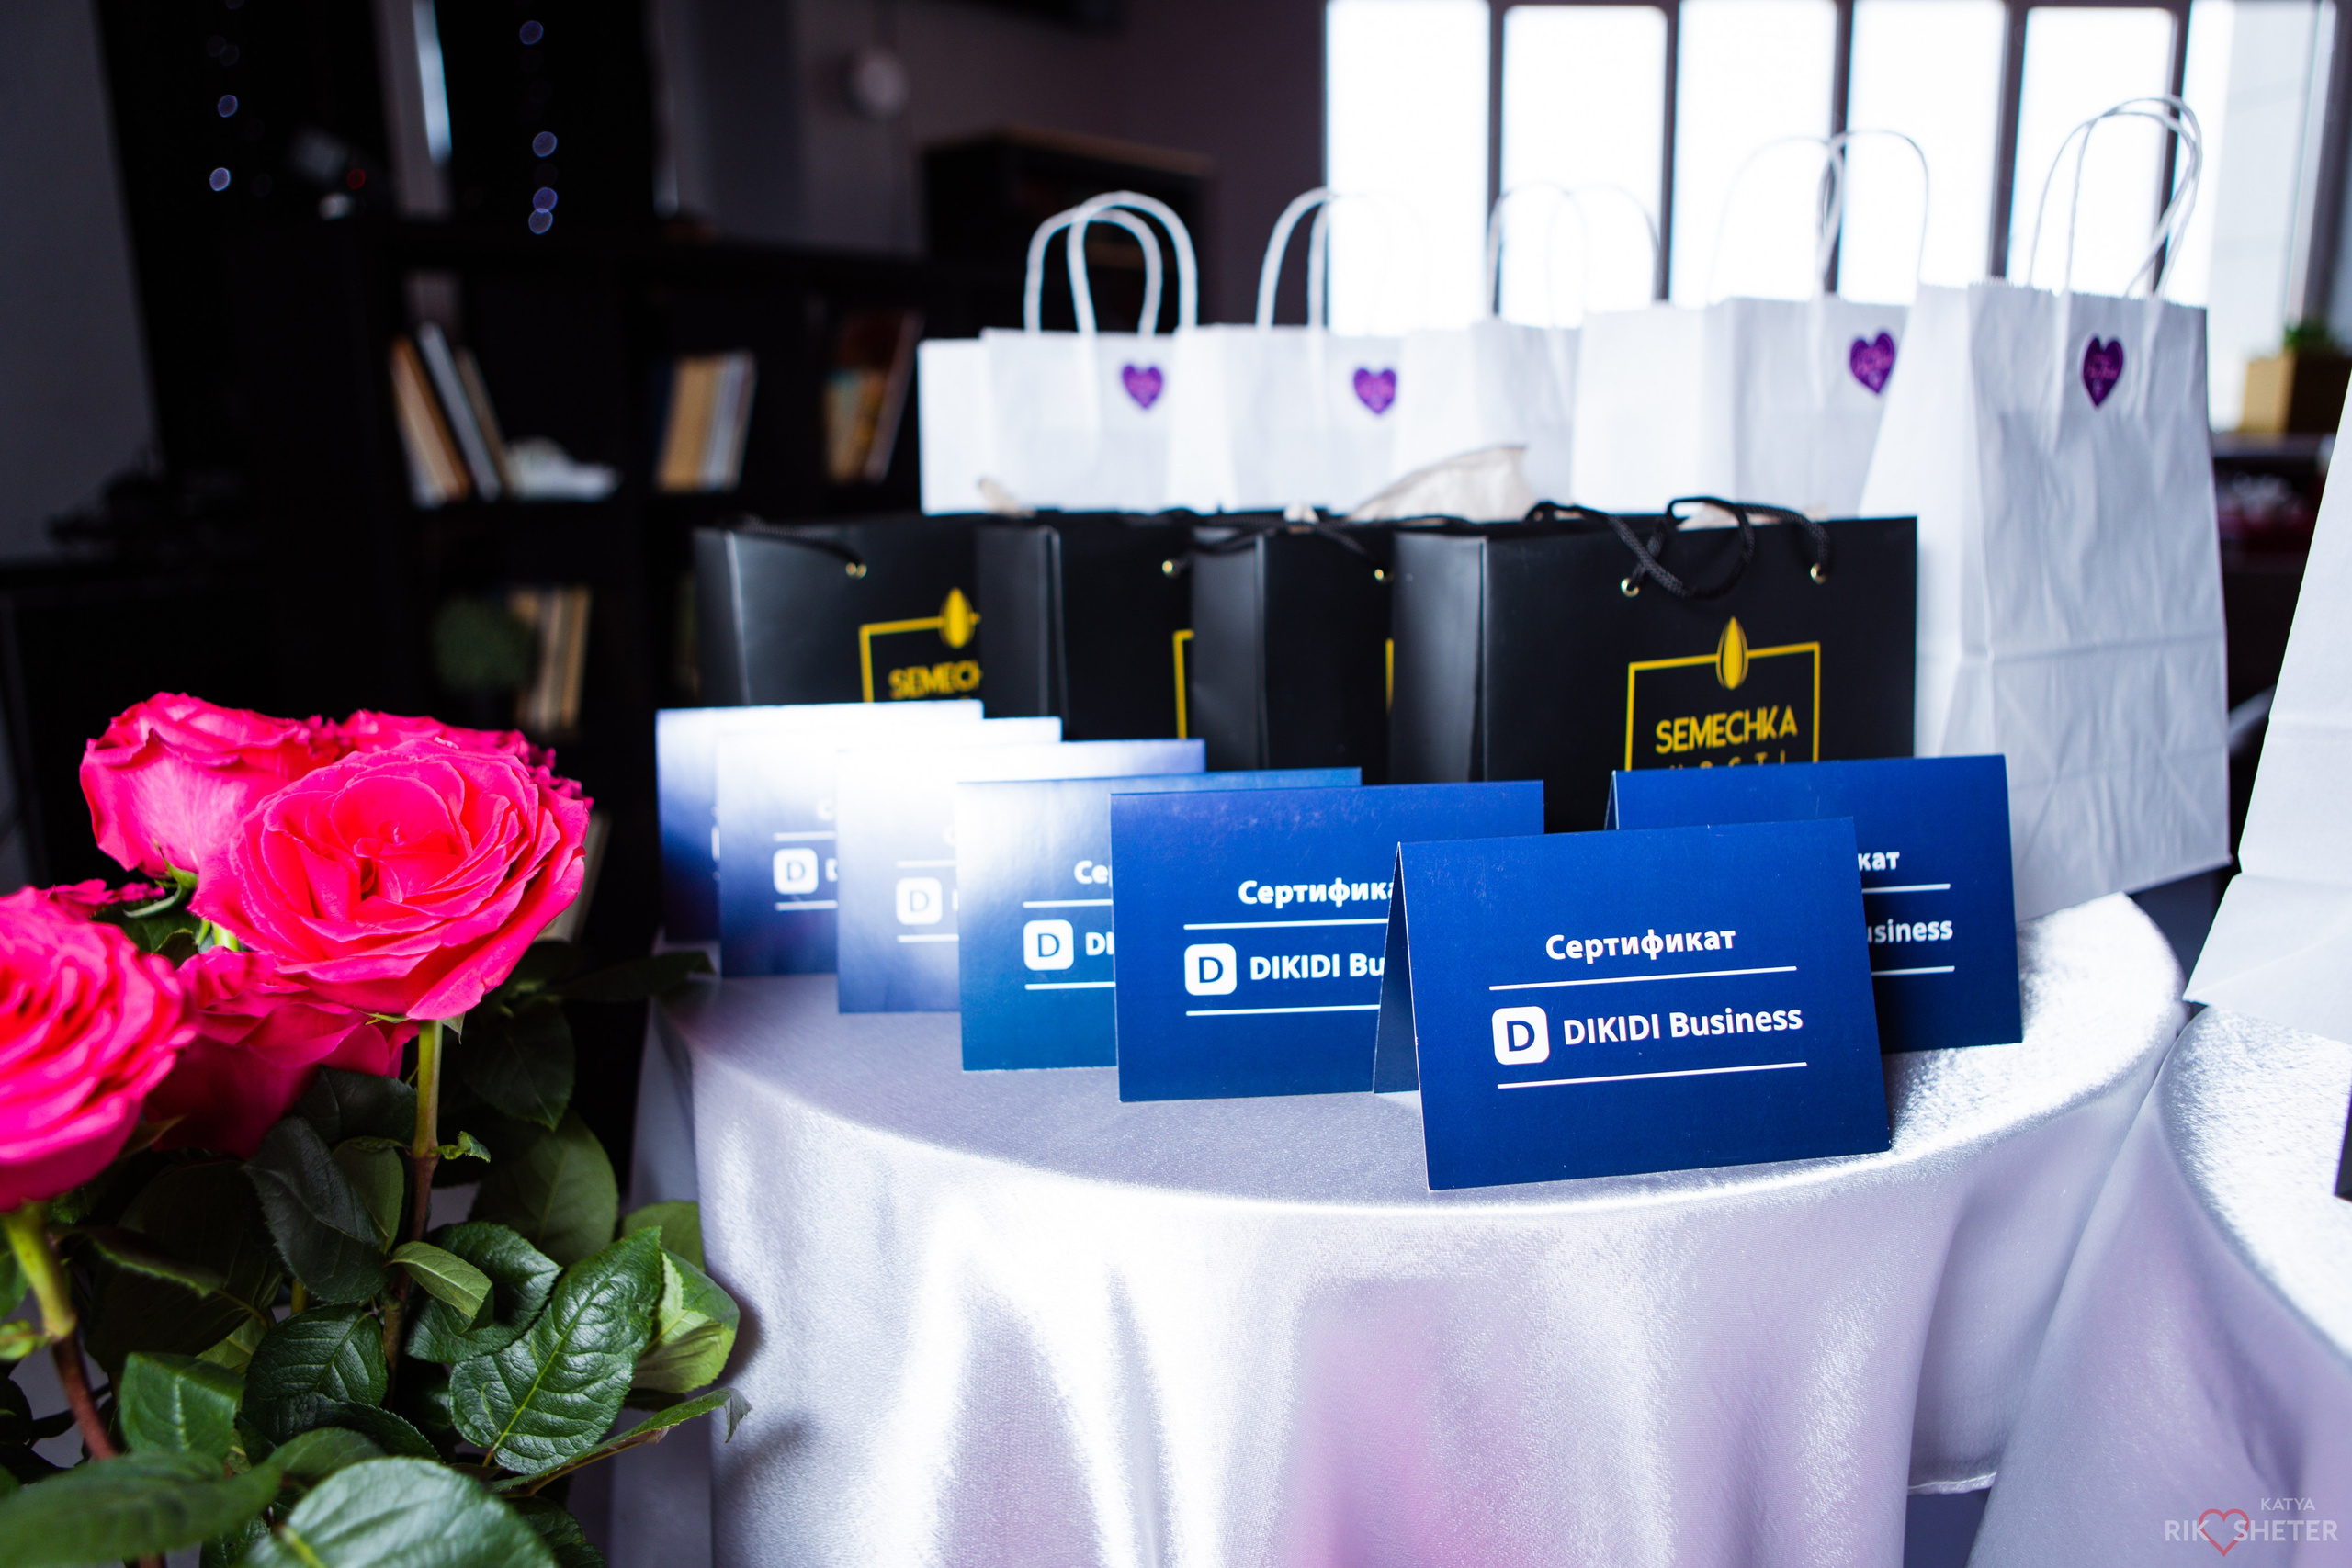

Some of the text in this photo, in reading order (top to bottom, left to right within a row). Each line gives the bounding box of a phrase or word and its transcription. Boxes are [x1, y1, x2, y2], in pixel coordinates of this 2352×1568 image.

[1656, 704, 1798, 755] SEMECHKA
[1073, 859, 1112, 888] Се
[1545, 929, 1736, 964] Сертификат
[1250, 953, 1340, 980] DIKIDI
[1563, 1013, 1660, 1045] DIKIDI
[1669, 1007, 1804, 1038] Business
